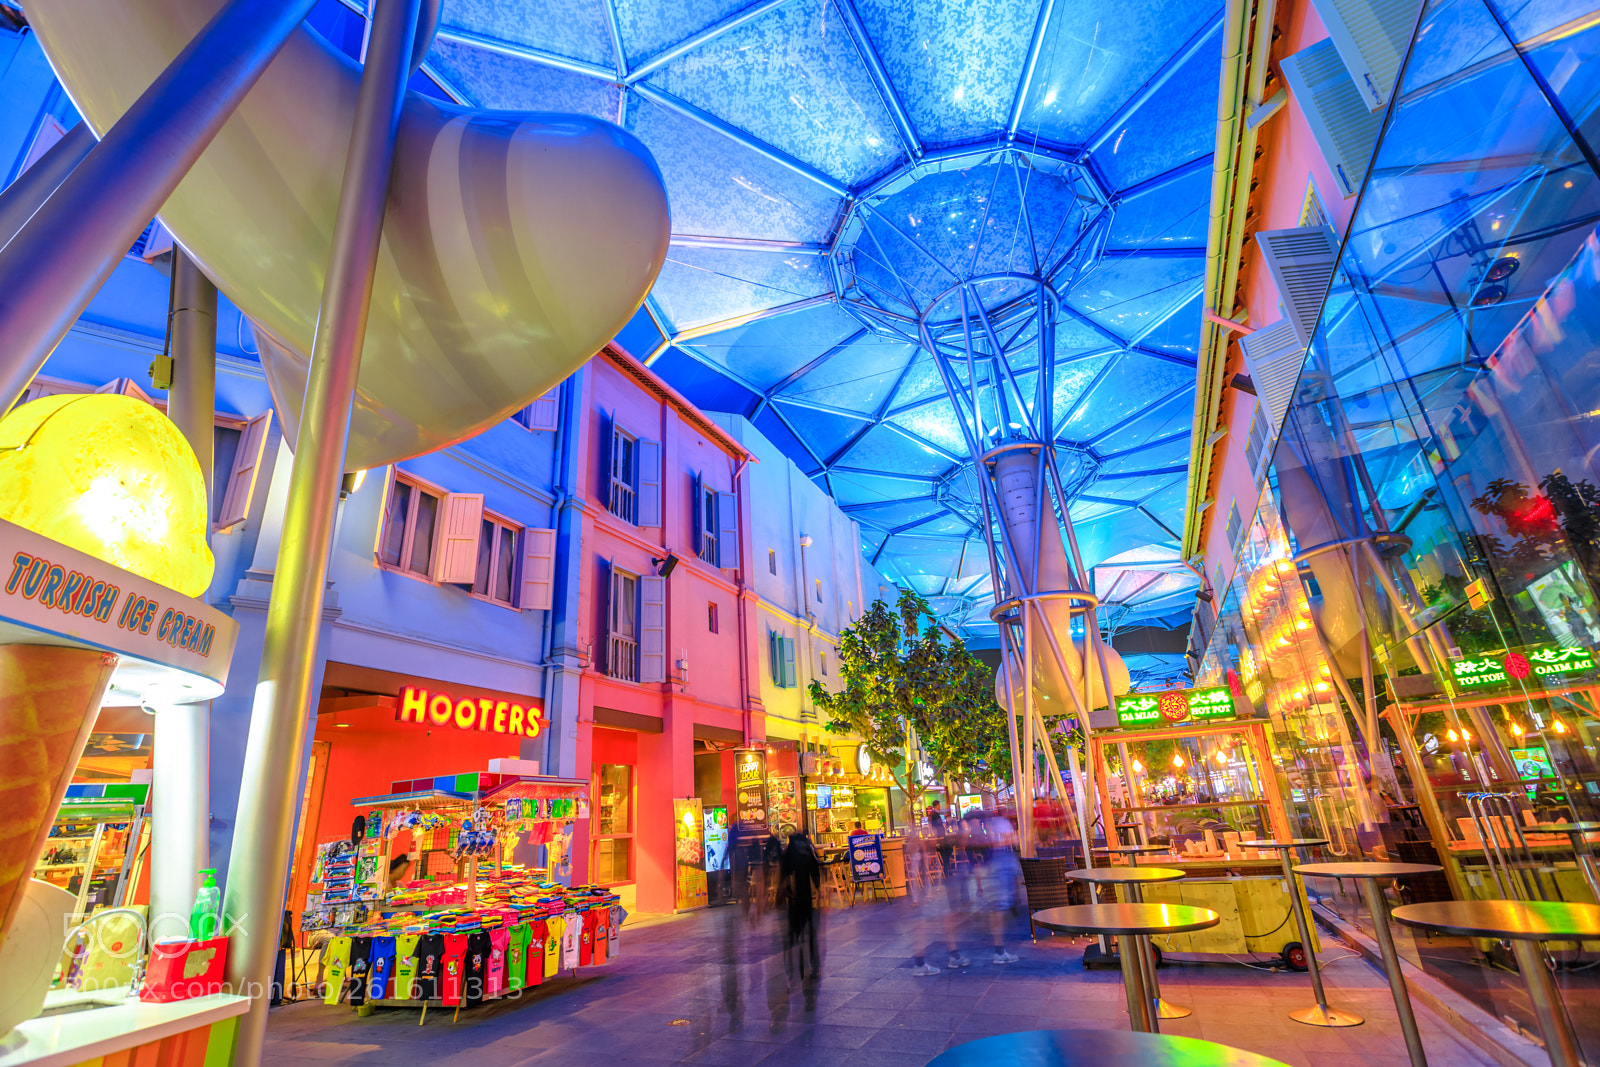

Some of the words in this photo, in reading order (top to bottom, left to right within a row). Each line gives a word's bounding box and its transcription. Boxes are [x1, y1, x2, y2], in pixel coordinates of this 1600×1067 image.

[5, 551, 120, 623] TURKISH
[118, 592, 159, 636] ICE
[157, 608, 215, 657] CREAM
[399, 685, 542, 738] HOOTERS
[1121, 713, 1134, 721] DA
[1135, 711, 1159, 720] MIAO
[1191, 706, 1211, 715] HOT
[1212, 704, 1231, 714] POT
